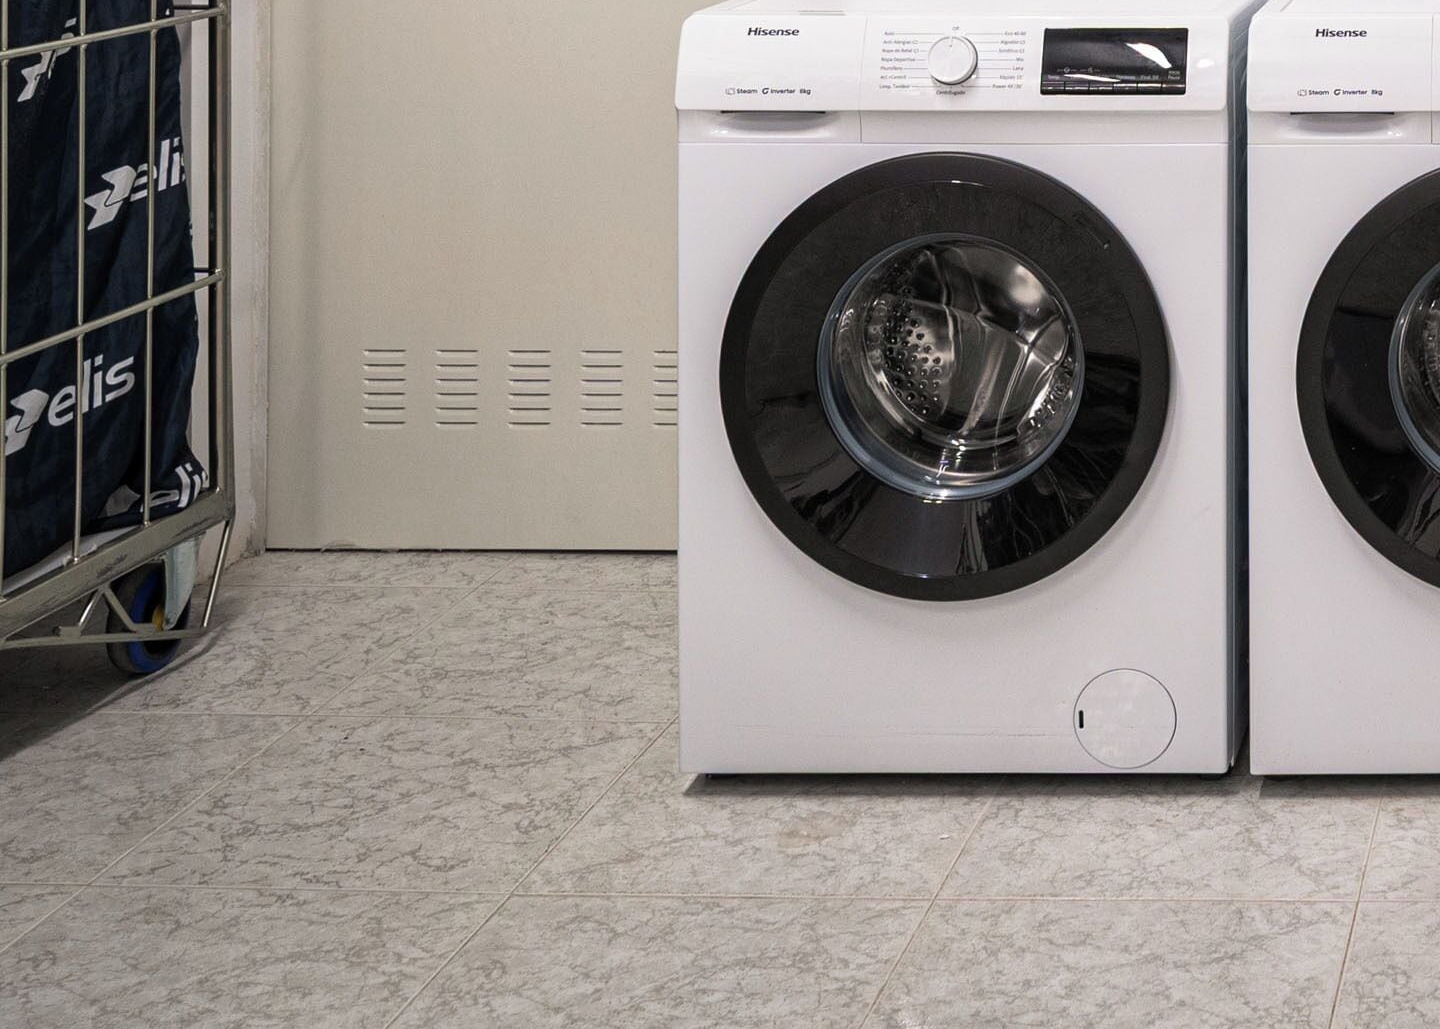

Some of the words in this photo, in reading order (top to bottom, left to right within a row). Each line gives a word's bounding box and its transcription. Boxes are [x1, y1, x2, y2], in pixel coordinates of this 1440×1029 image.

[747, 27, 799, 36] Hisense
[1315, 28, 1367, 38] Hisense
[130, 136, 186, 203] eli
[47, 354, 135, 427] elis
